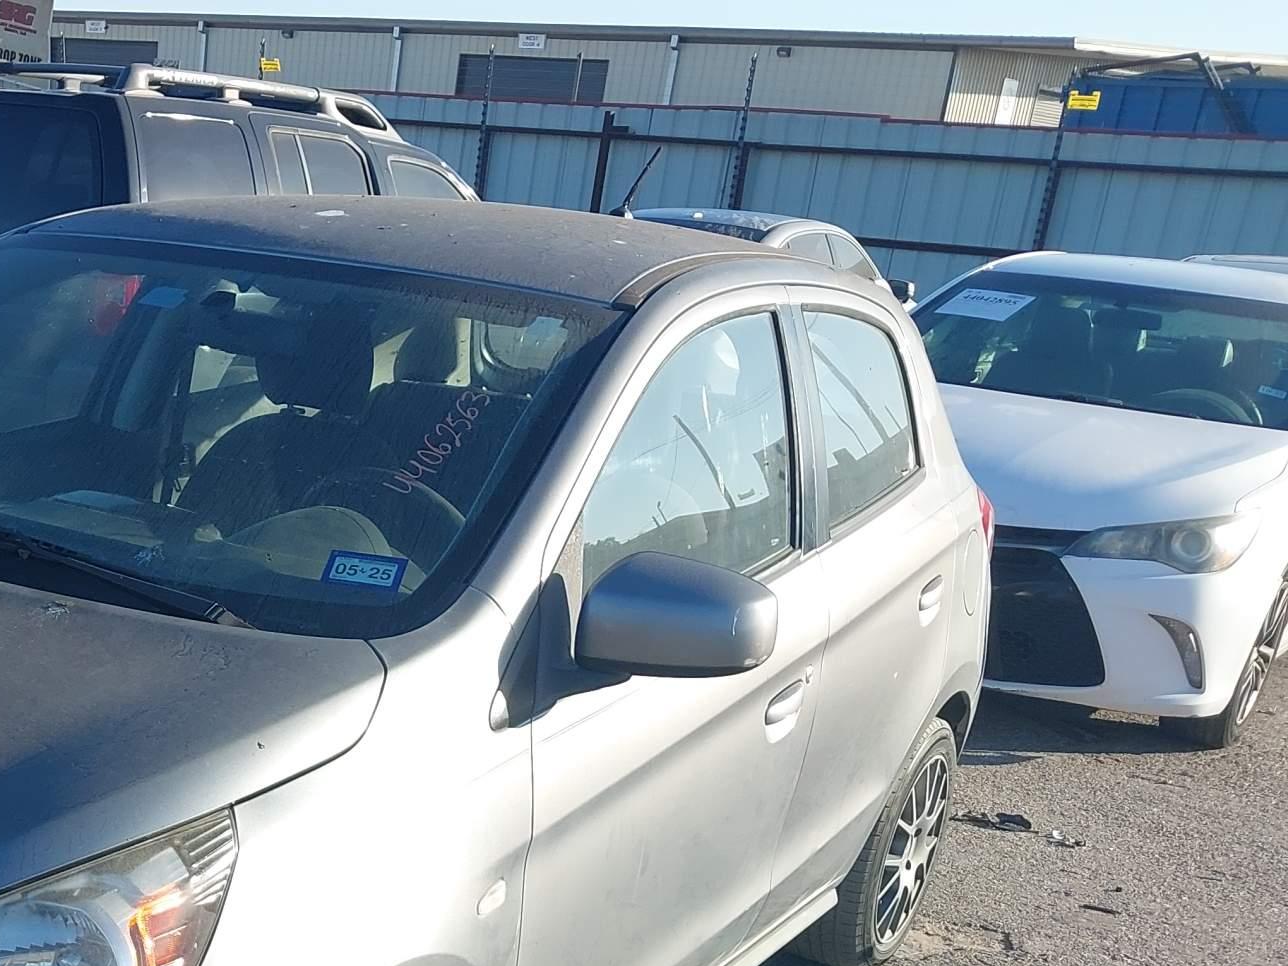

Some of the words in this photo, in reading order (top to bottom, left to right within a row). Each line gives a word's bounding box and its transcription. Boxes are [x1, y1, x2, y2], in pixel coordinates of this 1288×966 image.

[381, 390, 491, 494] 44062563
[334, 562, 360, 577] 05
[367, 567, 393, 581] 25
